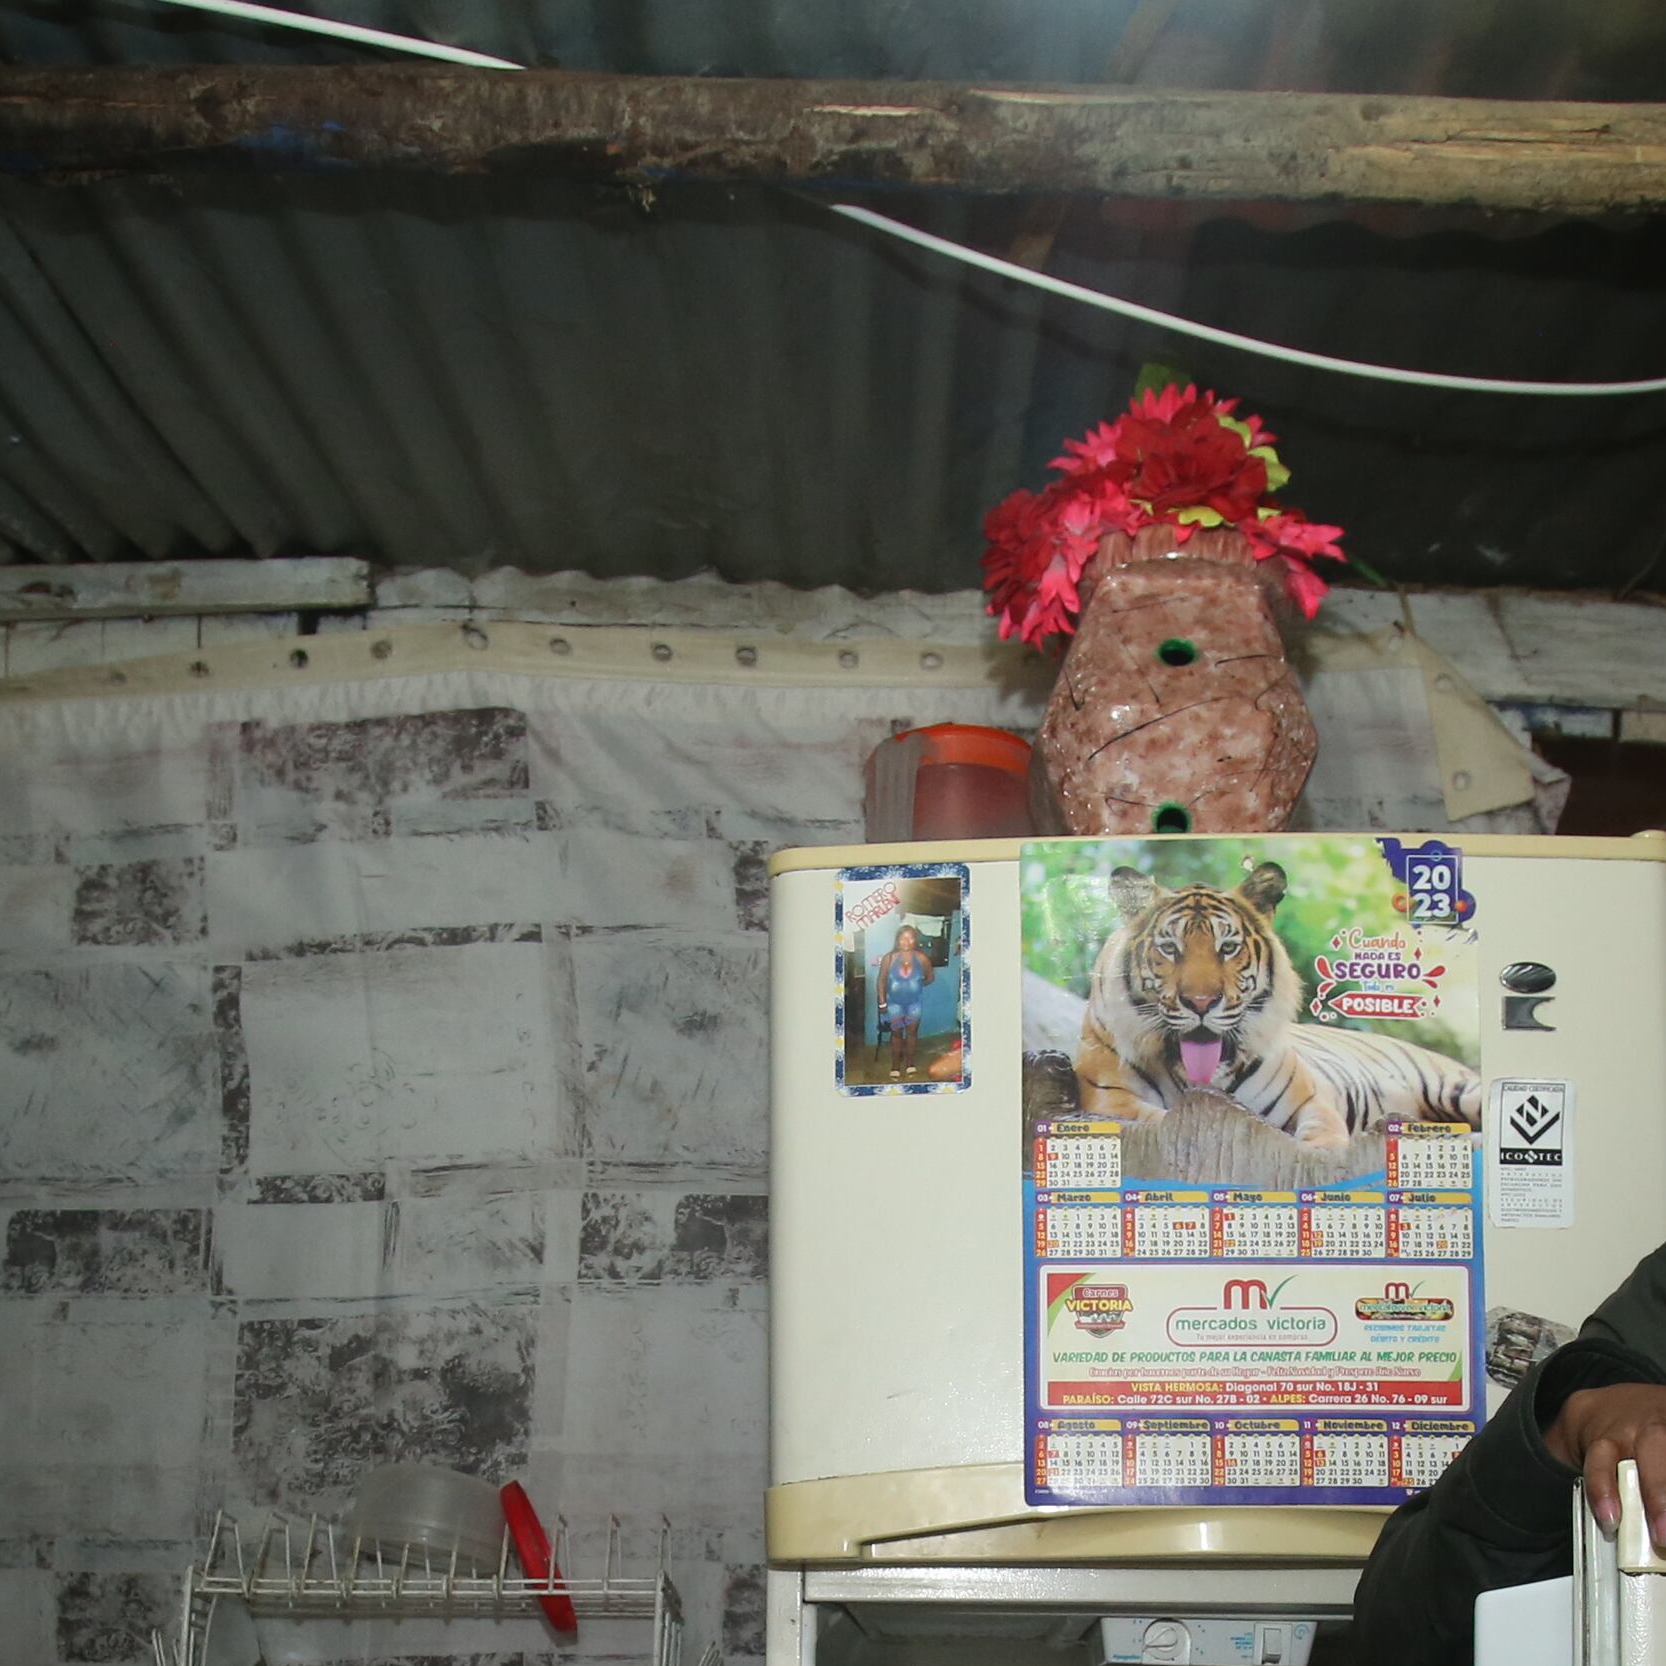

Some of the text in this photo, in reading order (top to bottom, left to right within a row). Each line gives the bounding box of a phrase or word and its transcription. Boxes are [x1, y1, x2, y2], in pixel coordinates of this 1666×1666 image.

[1413, 865, 1451, 890] 20
[1413, 893, 1451, 918] 23
[1349, 928, 1405, 949] Cuando
[1355, 952, 1401, 961] NADA ES
[1335, 962, 1421, 979] SEGURO
[1342, 999, 1414, 1014] POSIBLE
[1037, 1124, 1090, 1132] 01 Enero
[1388, 1124, 1451, 1132] 02 Febrero
[1057, 1193, 1092, 1202] Marzo
[1145, 1192, 1173, 1201] Abril
[1233, 1193, 1263, 1202] Mayo
[1321, 1192, 1351, 1201] Junio
[1409, 1193, 1436, 1202] Julio
[1083, 1288, 1119, 1298] Carnes
[1066, 1300, 1133, 1312] VICTORIA
[1175, 1316, 1327, 1330] mercados victoria
[1053, 1352, 1457, 1362] VARIEDAD DE PRODUCTOS PARA LA CANASTA FAMILIAR AL MEJOR PRECIO
[1131, 1383, 1161, 1392] VISTA
[1165, 1383, 1223, 1392] HERMOSA:
[1226, 1382, 1277, 1393] Diagonal
[1280, 1382, 1294, 1391] 70
[1317, 1382, 1335, 1391] No.
[1338, 1382, 1357, 1391] 18J
[1366, 1382, 1379, 1391] 31
[1063, 1394, 1115, 1404] PARAÍSO:
[1117, 1394, 1147, 1404] Calle
[1150, 1394, 1173, 1404] 72C
[1197, 1394, 1213, 1404] No.
[1217, 1394, 1237, 1404] 27B
[1247, 1394, 1261, 1404] 02
[1269, 1395, 1306, 1404] ALPES:
[1309, 1394, 1351, 1404] Carrera
[1355, 1394, 1369, 1404] 26
[1371, 1394, 1389, 1404] No.
[1392, 1394, 1406, 1404] 76
[1414, 1394, 1428, 1404] 09
[1431, 1396, 1448, 1404] sur
[1057, 1421, 1095, 1430] Agosto
[1143, 1421, 1209, 1431] Septiembre
[1234, 1421, 1281, 1429] Octubre
[1304, 1421, 1383, 1430] 11 Noviembre
[1411, 1421, 1469, 1430] Diciembre
